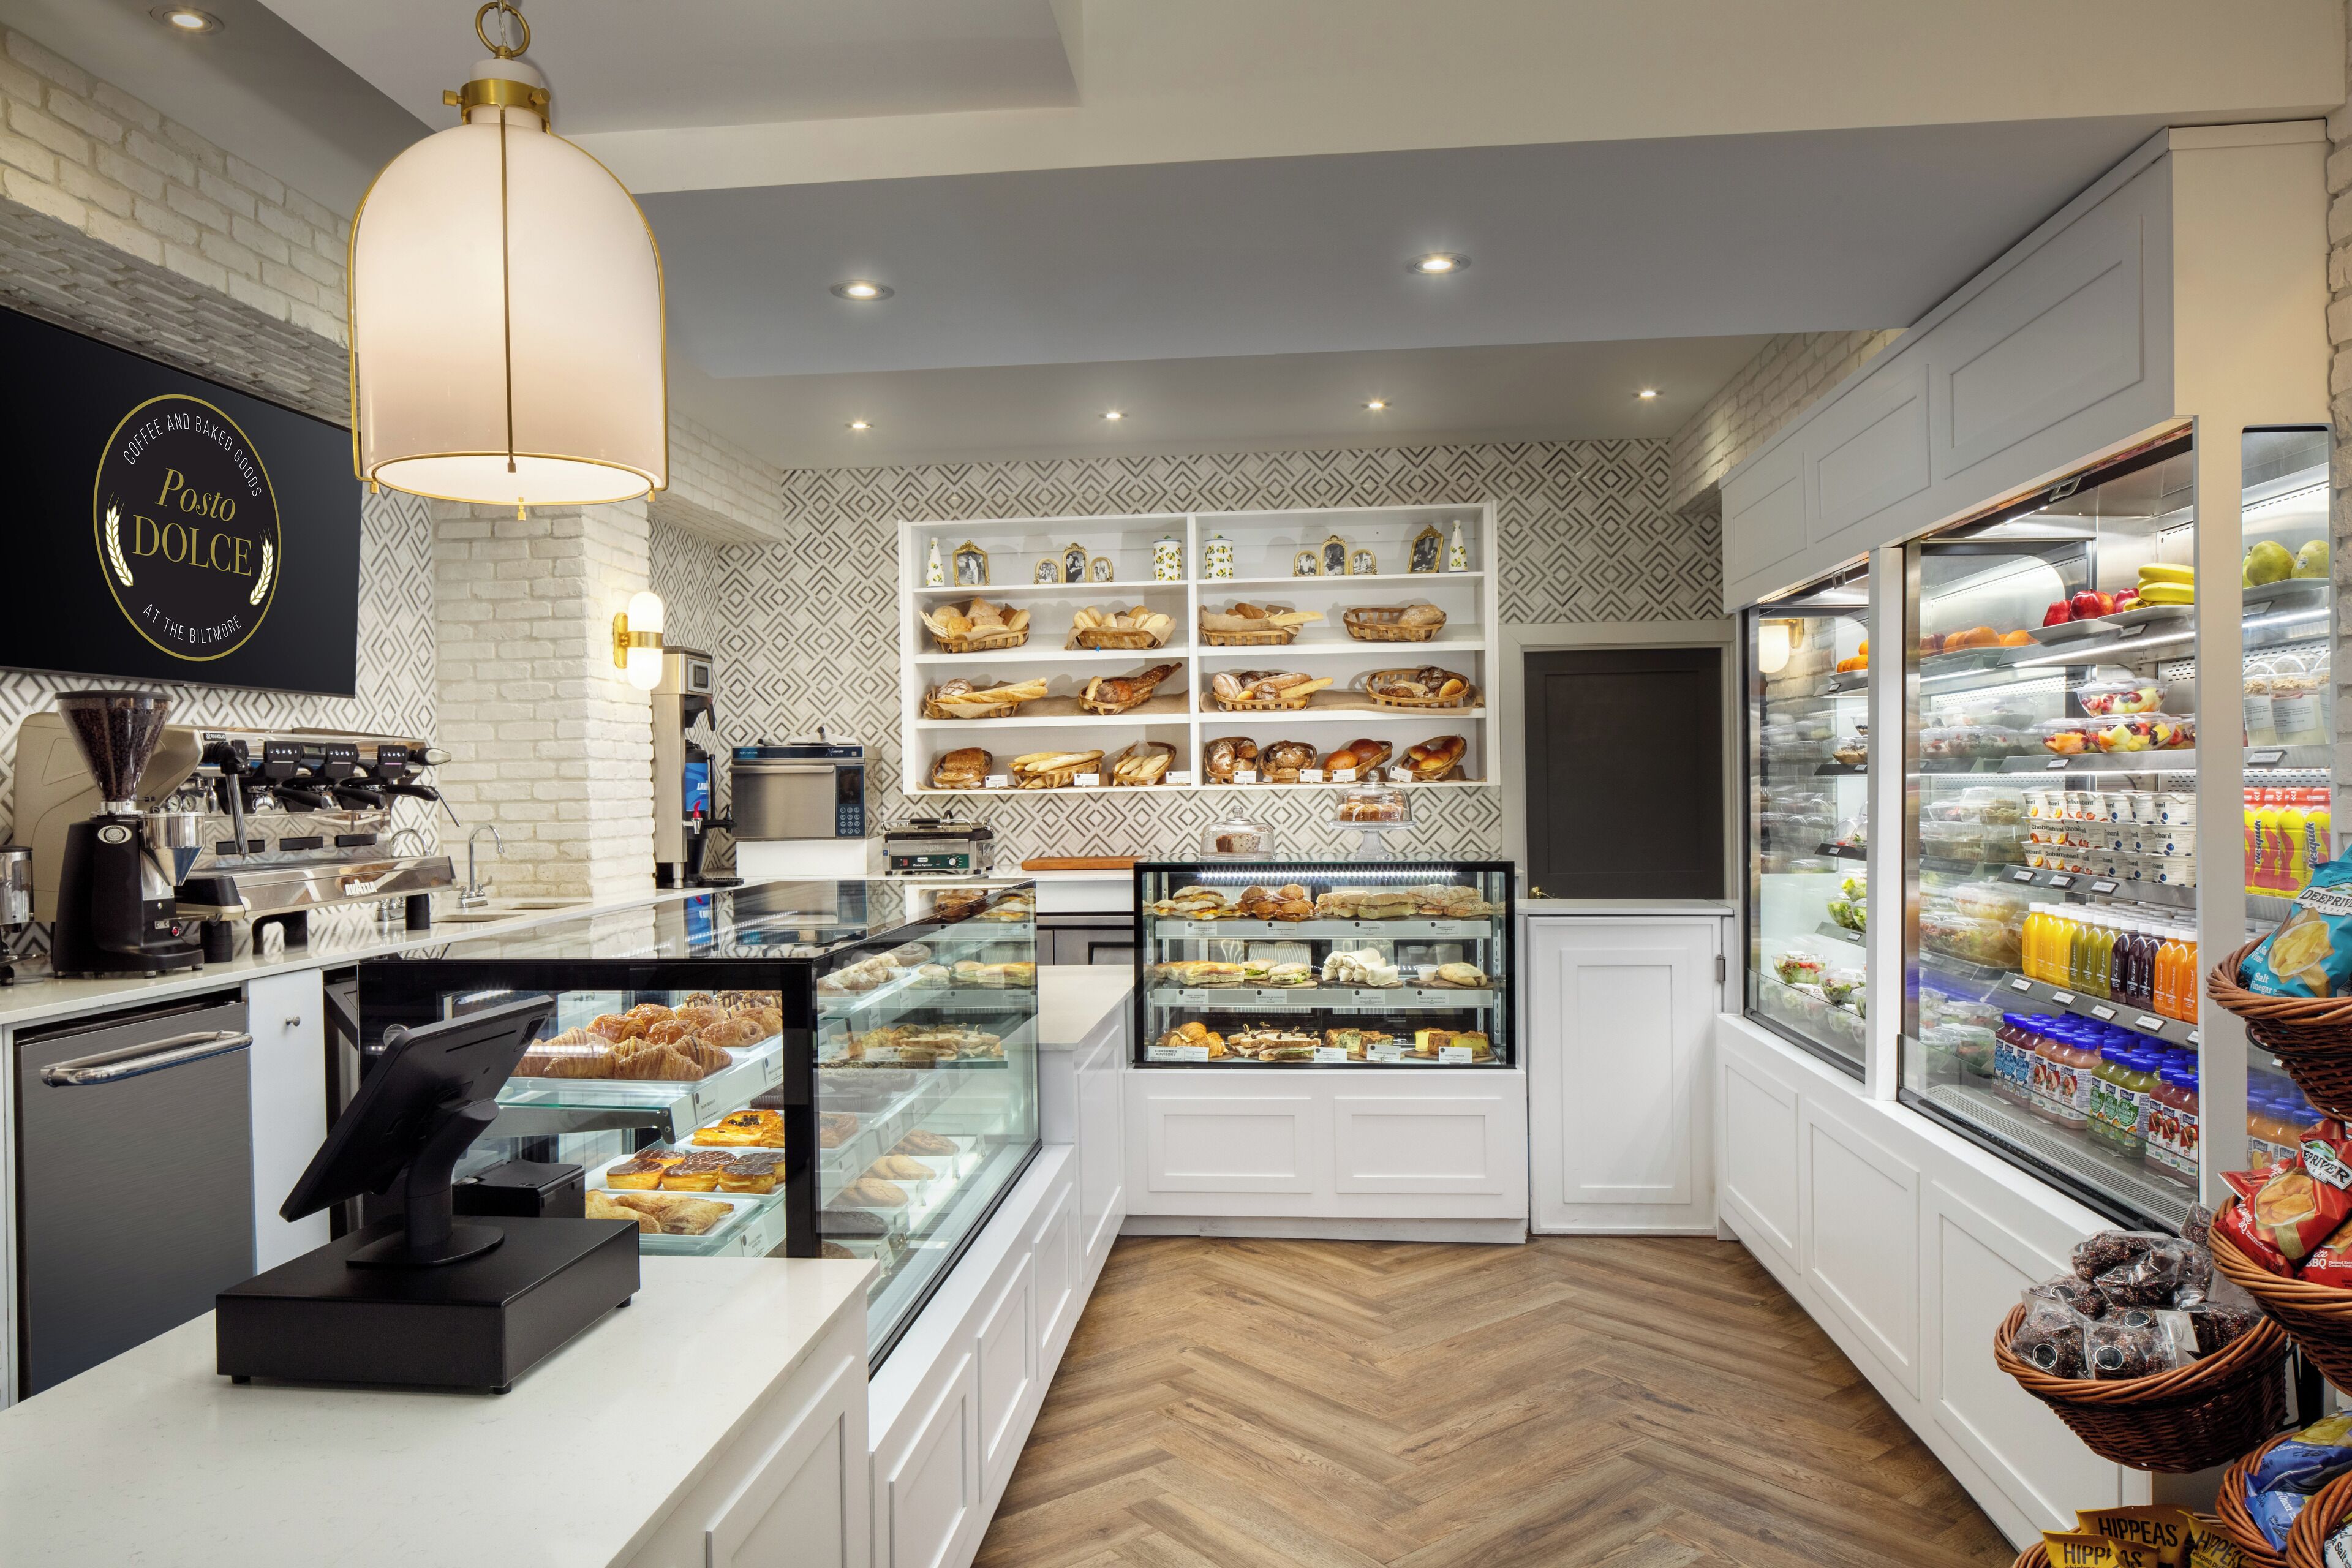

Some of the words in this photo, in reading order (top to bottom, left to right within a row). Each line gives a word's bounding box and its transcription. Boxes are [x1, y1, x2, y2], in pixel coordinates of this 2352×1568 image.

[123, 418, 164, 465] COFFEE
[167, 413, 190, 431] AND
[195, 416, 233, 451] BAKED
[233, 448, 262, 497] GOODS
[154, 467, 236, 522] Posto
[132, 514, 252, 576] DOLCE
[143, 603, 161, 624] AT
[164, 617, 184, 641] THE
[189, 614, 241, 644] BILTMORE
[2255, 820, 2264, 864] Nesquik
[2307, 822, 2320, 869] Nesquik
[345, 879, 377, 896] AVAZZA
[2255, 972, 2269, 984] Salt
[2254, 1141, 2267, 1151] Naked
[2302, 1150, 2350, 1183] EPRIVER
[2278, 1496, 2293, 1512] Onion
[2098, 1517, 2178, 1548] HIPPEAS
[2334, 1540, 2347, 1562] Salt
